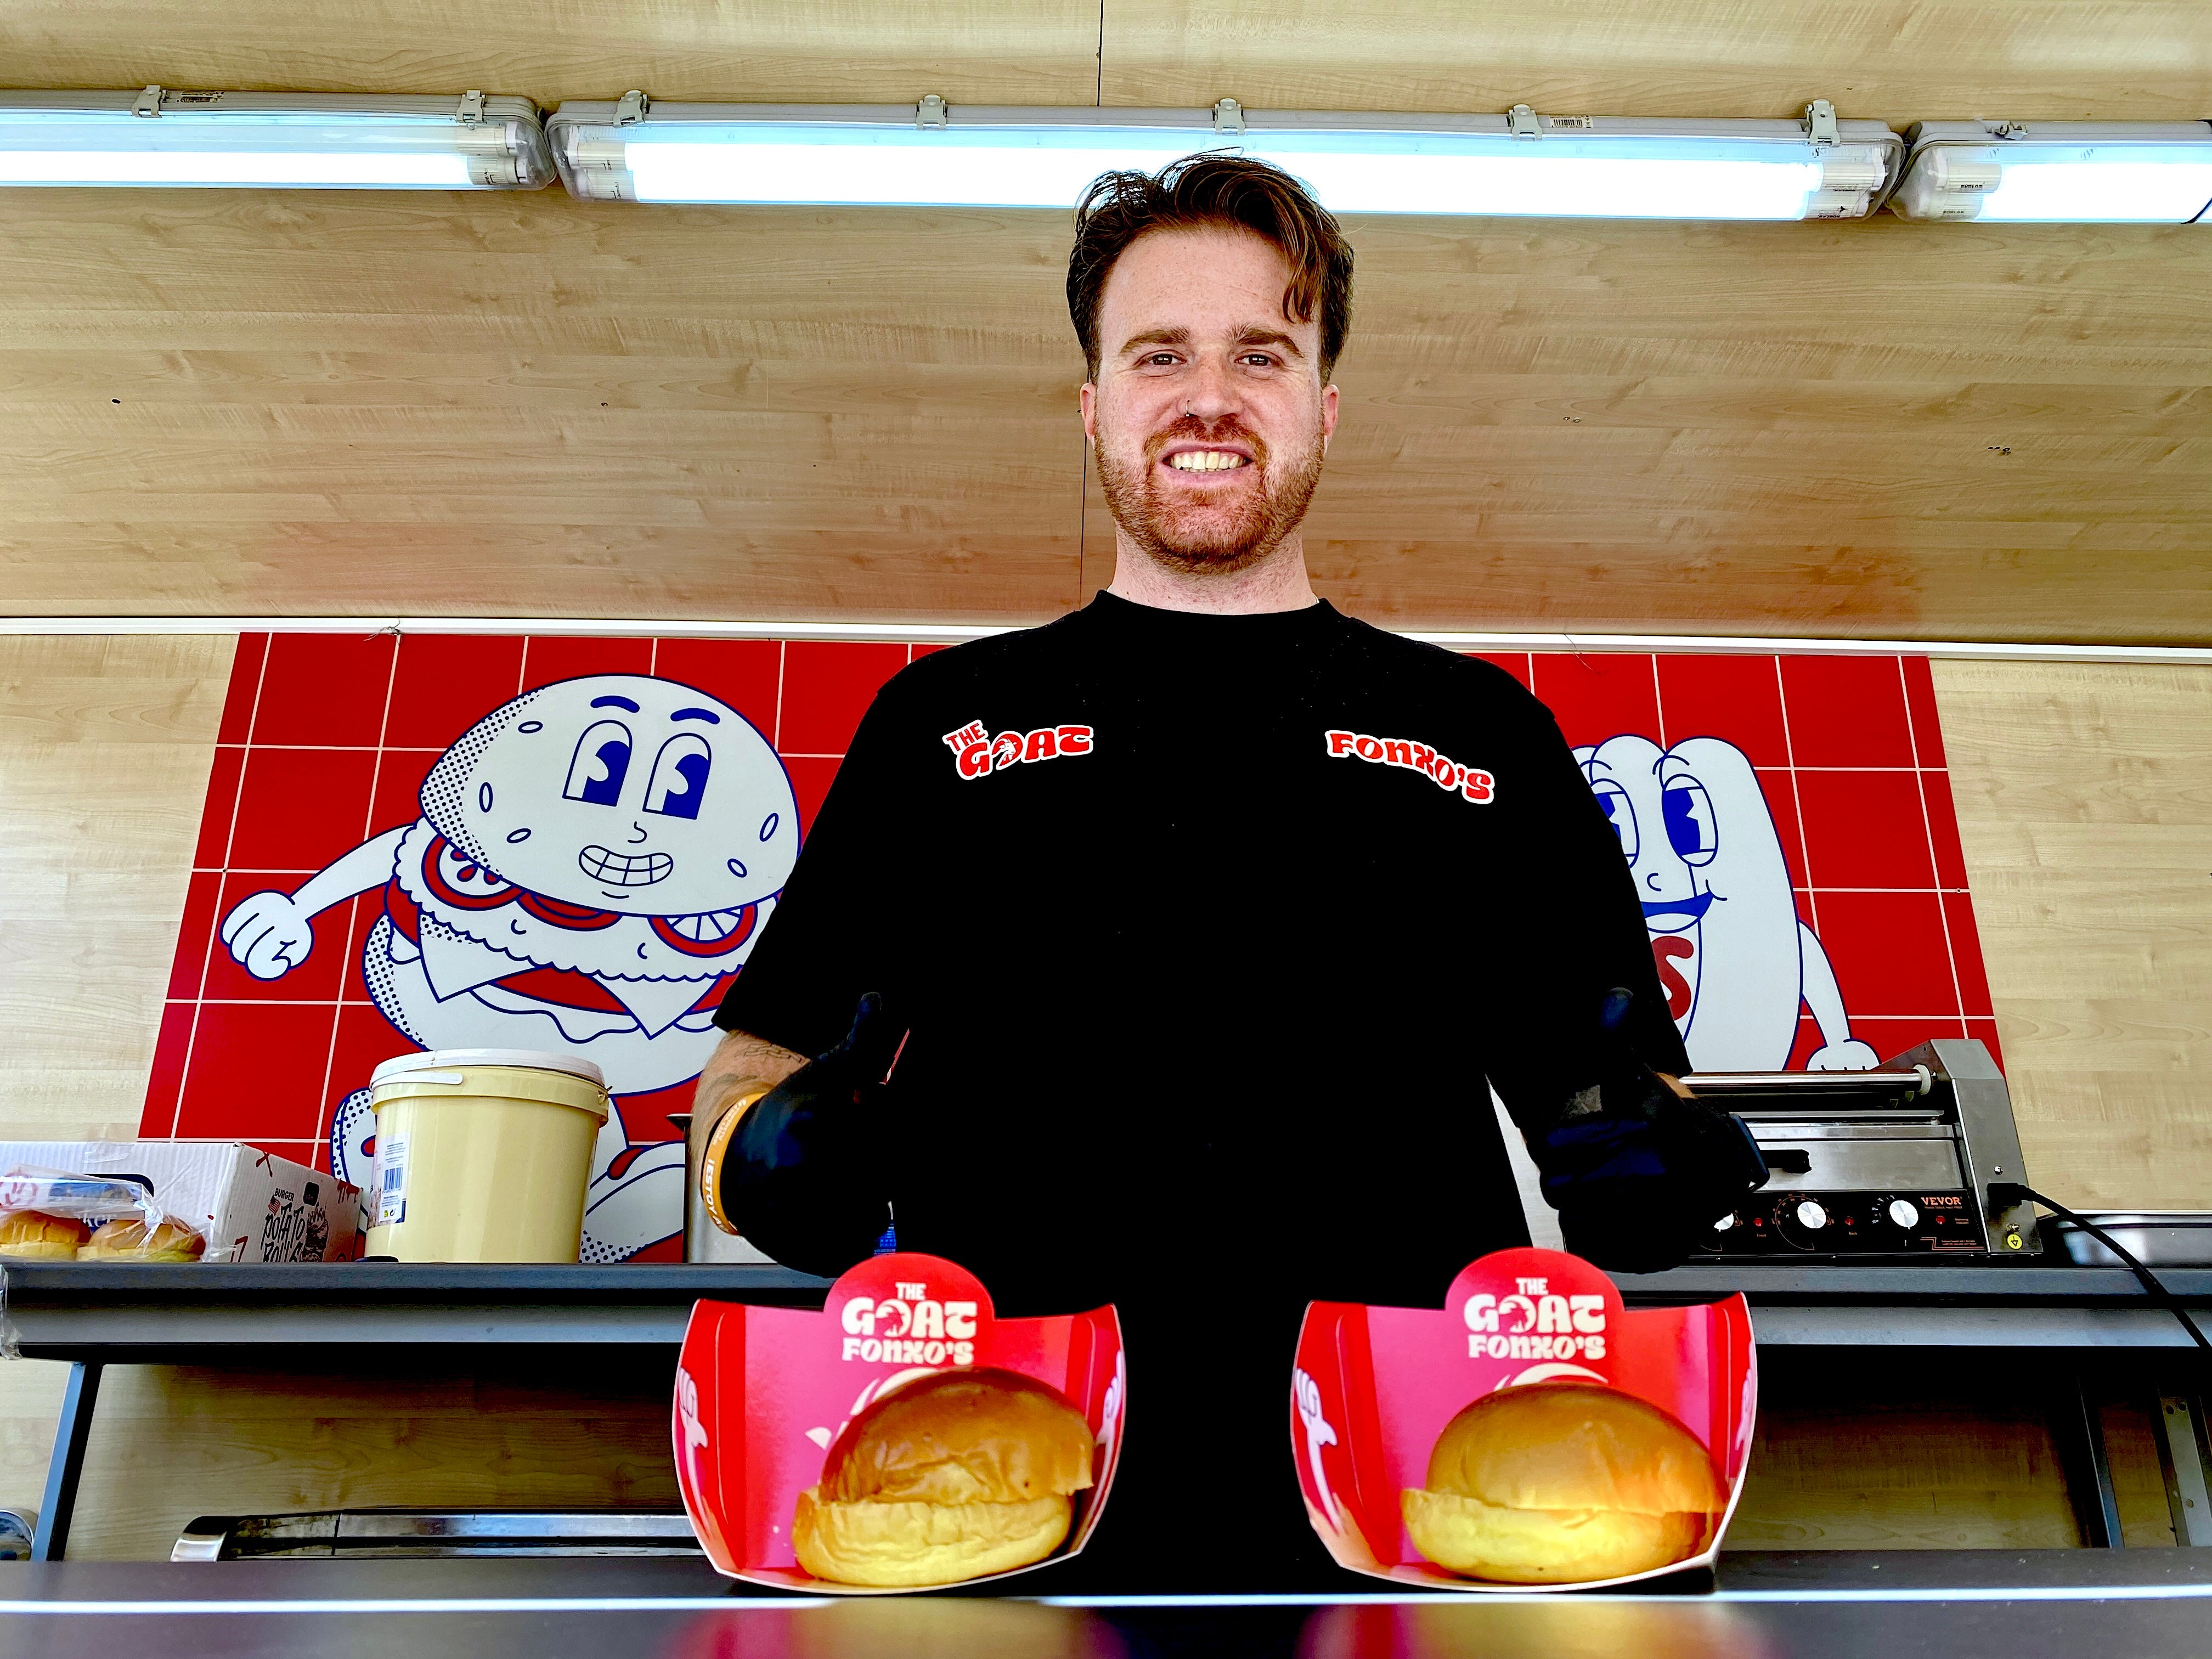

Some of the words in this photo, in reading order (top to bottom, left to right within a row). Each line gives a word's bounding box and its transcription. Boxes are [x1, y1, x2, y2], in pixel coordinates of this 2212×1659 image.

[944, 721, 987, 752] THE
[957, 725, 1092, 778] GOAT
[274, 1188, 295, 1202] BURGER
[1920, 1197, 1962, 1205] VEVOR
[260, 1201, 306, 1250] POTATO
[895, 1281, 927, 1301] THE
[1515, 1277, 1549, 1295] THE
[841, 1296, 978, 1340] GOAT
[1463, 1293, 1606, 1334] GOAT
[842, 1337, 975, 1365] FONXO'S
[1468, 1334, 1606, 1360] FONXO'S
